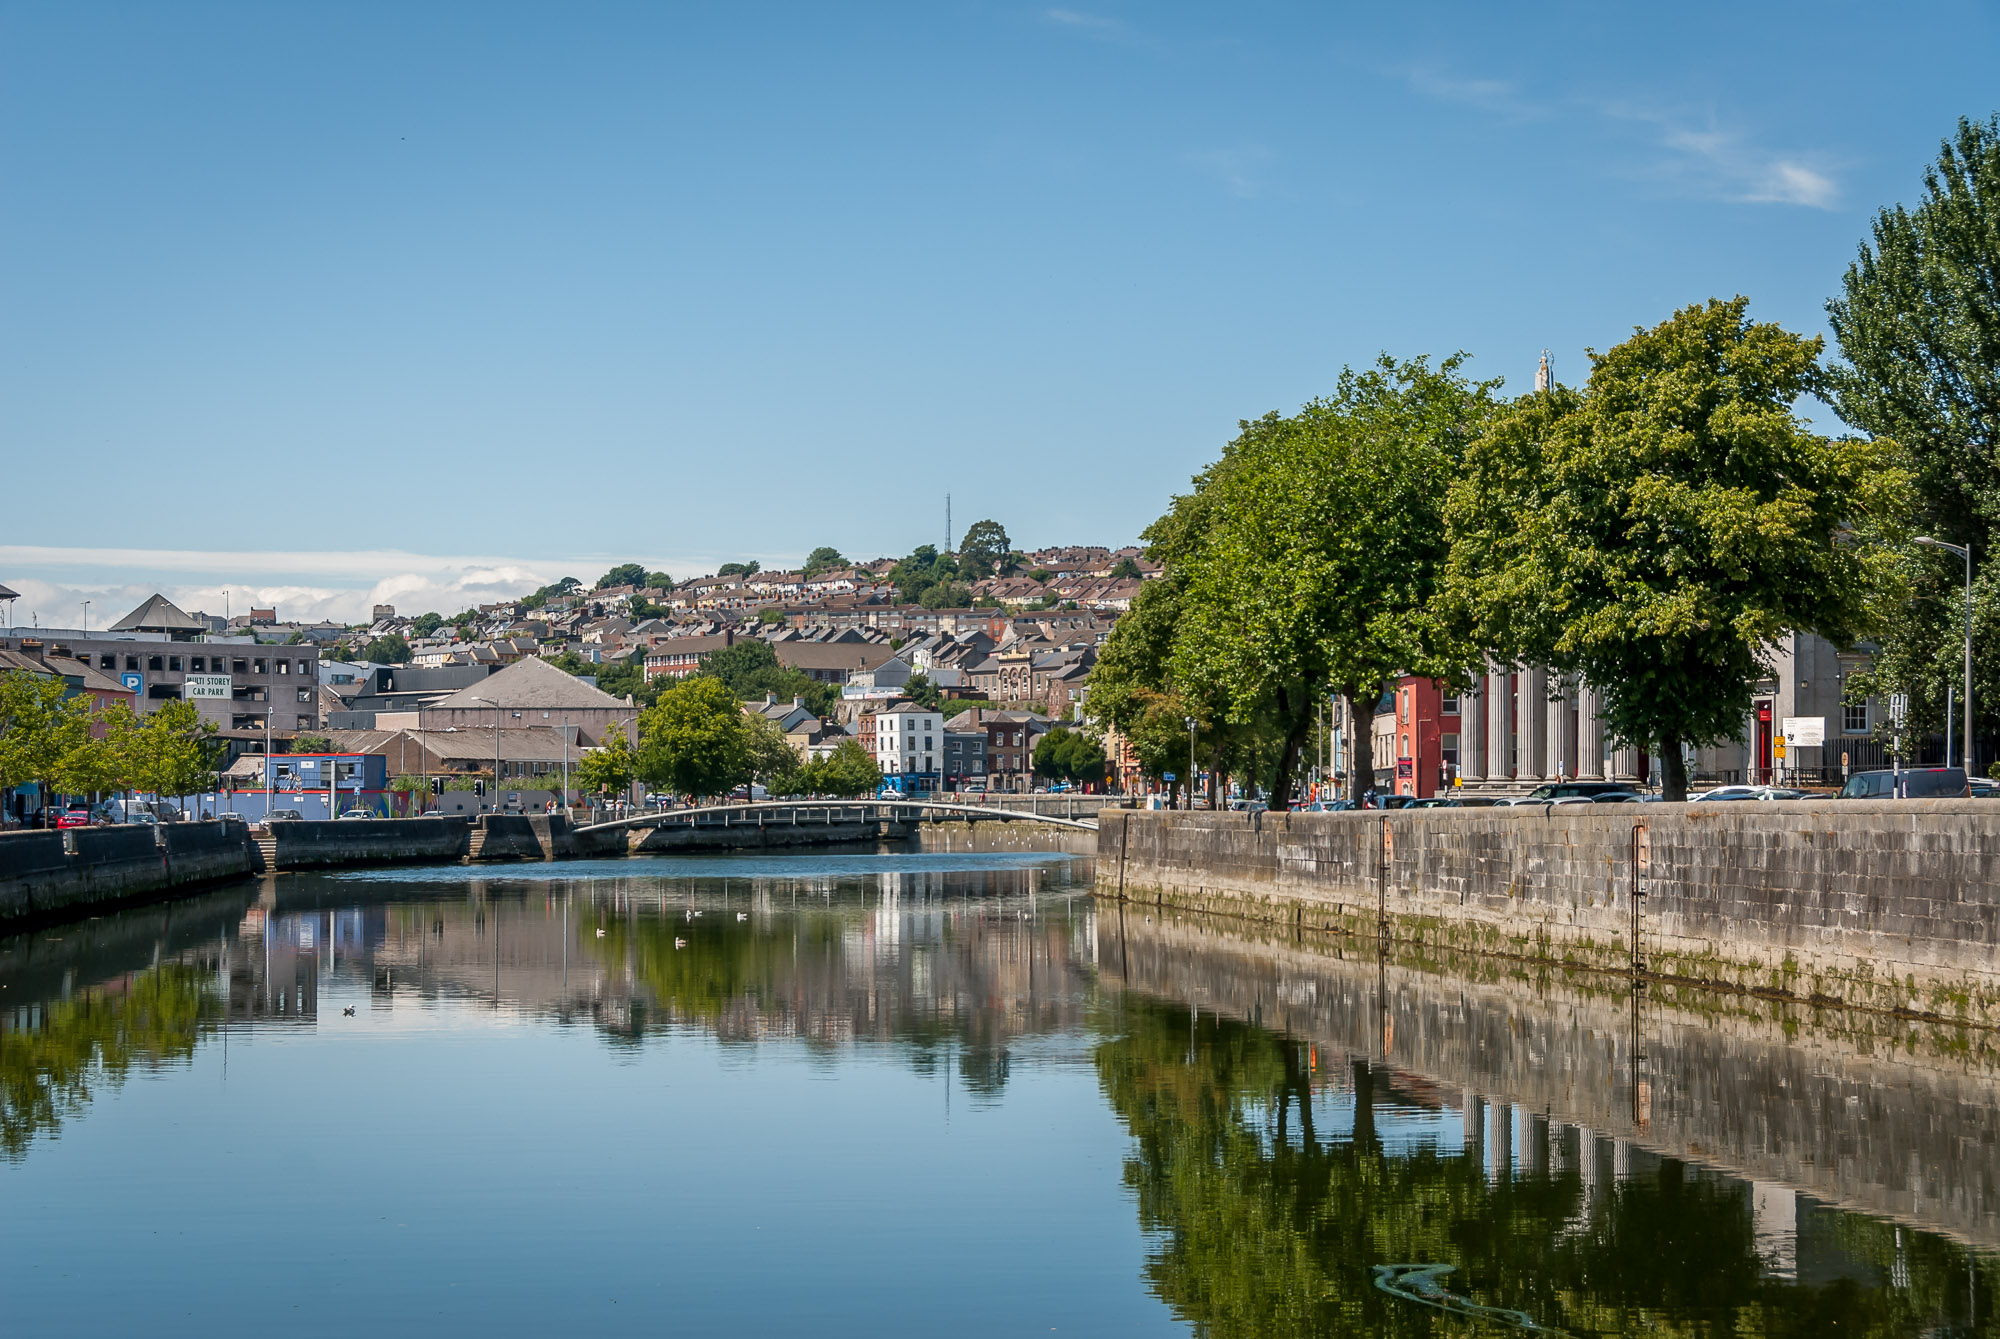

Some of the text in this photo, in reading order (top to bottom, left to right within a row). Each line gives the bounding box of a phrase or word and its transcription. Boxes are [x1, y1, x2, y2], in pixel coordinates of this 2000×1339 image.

[127, 677, 139, 688] P
[187, 677, 230, 685] MULTI STOREY
[193, 687, 224, 696] CAR PARK
